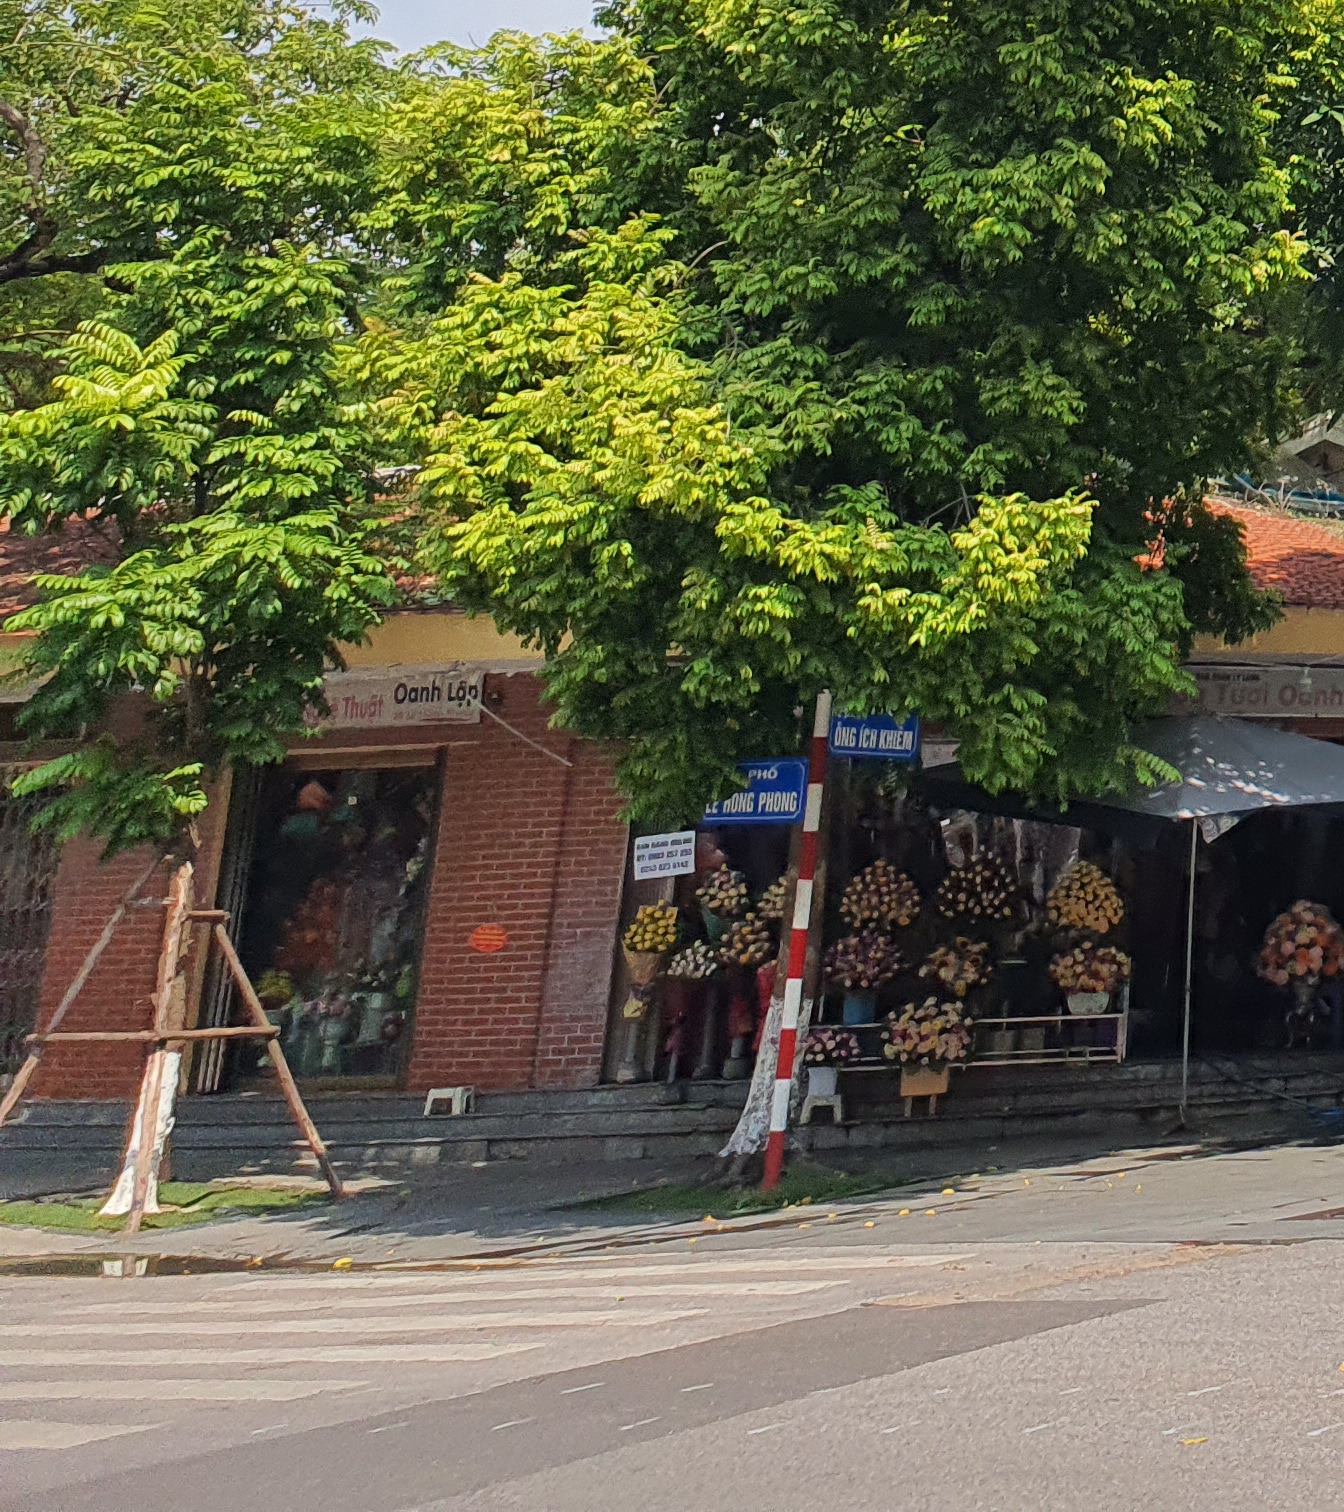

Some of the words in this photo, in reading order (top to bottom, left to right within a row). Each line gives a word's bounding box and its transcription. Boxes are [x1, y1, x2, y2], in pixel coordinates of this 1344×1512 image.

[394, 679, 441, 705] Oanh
[1278, 685, 1343, 708] Oanh
[859, 723, 878, 749] ÍCH
[757, 790, 798, 814] PHONG
